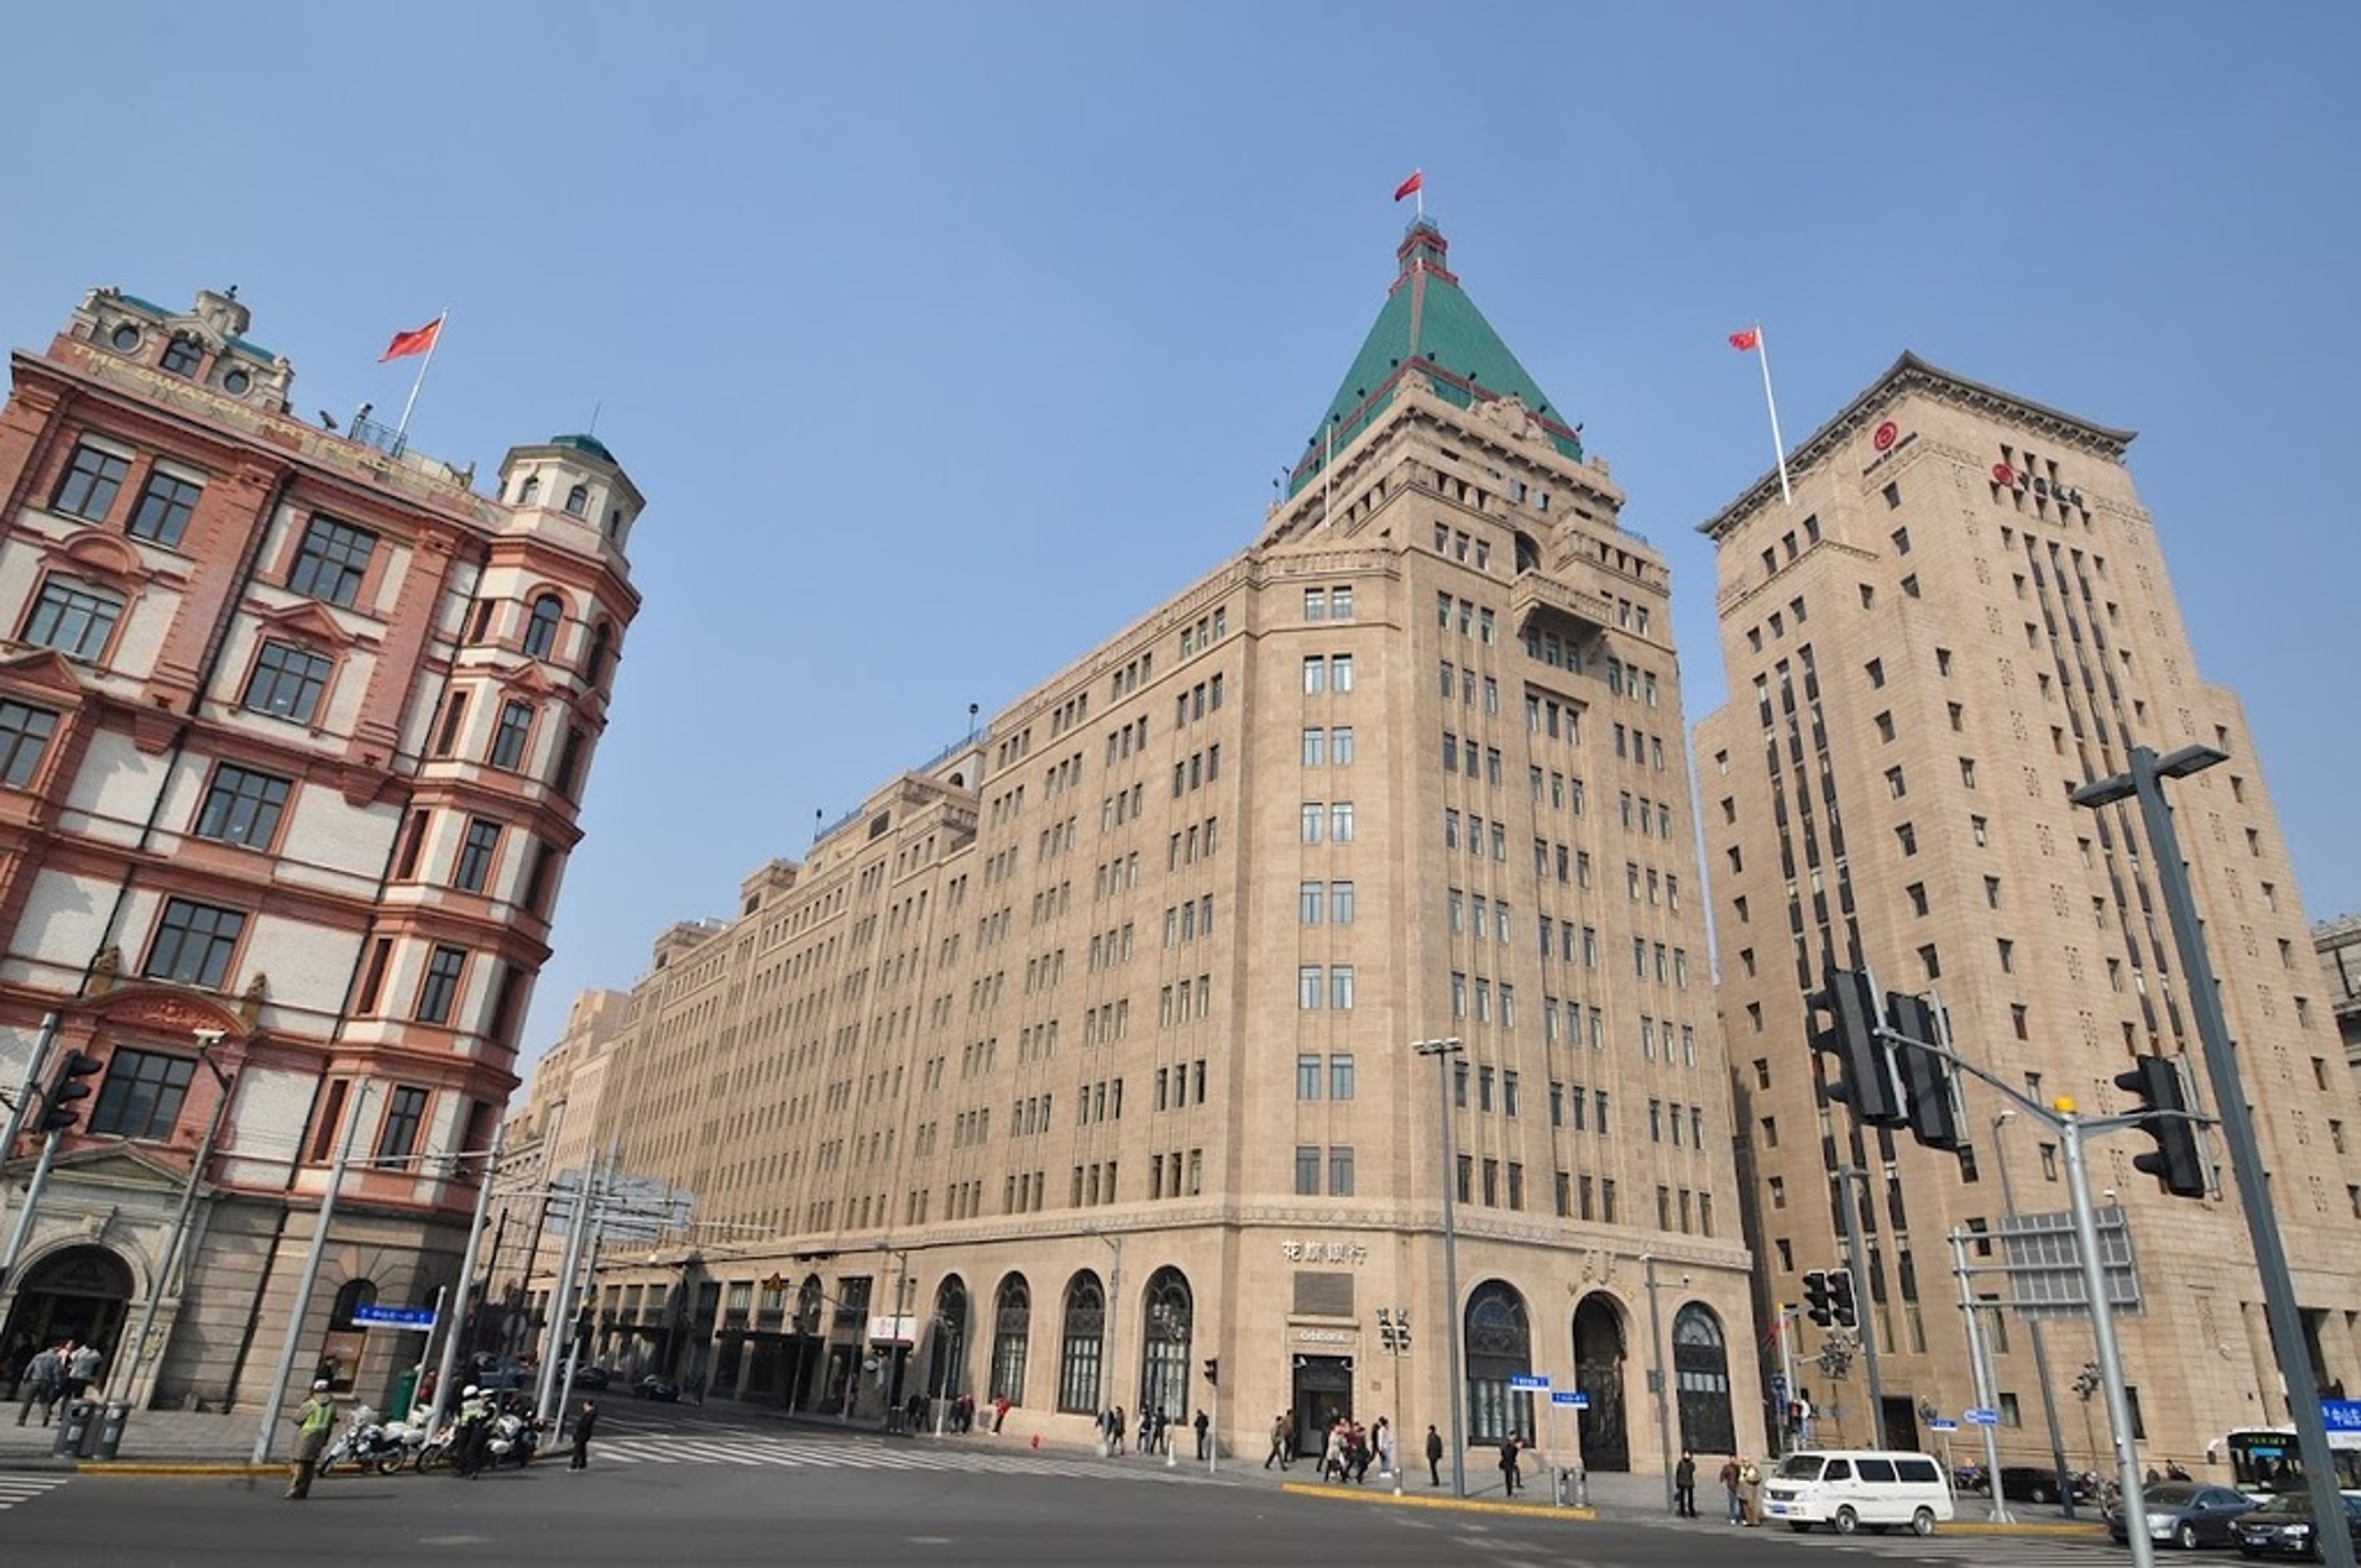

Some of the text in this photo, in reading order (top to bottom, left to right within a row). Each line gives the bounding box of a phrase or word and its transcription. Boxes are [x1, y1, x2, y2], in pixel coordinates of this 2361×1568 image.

[73, 343, 126, 370] THE
[135, 369, 251, 417] SWATCH
[259, 416, 310, 442] ART
[1283, 1240, 1366, 1265] 花旗银行
